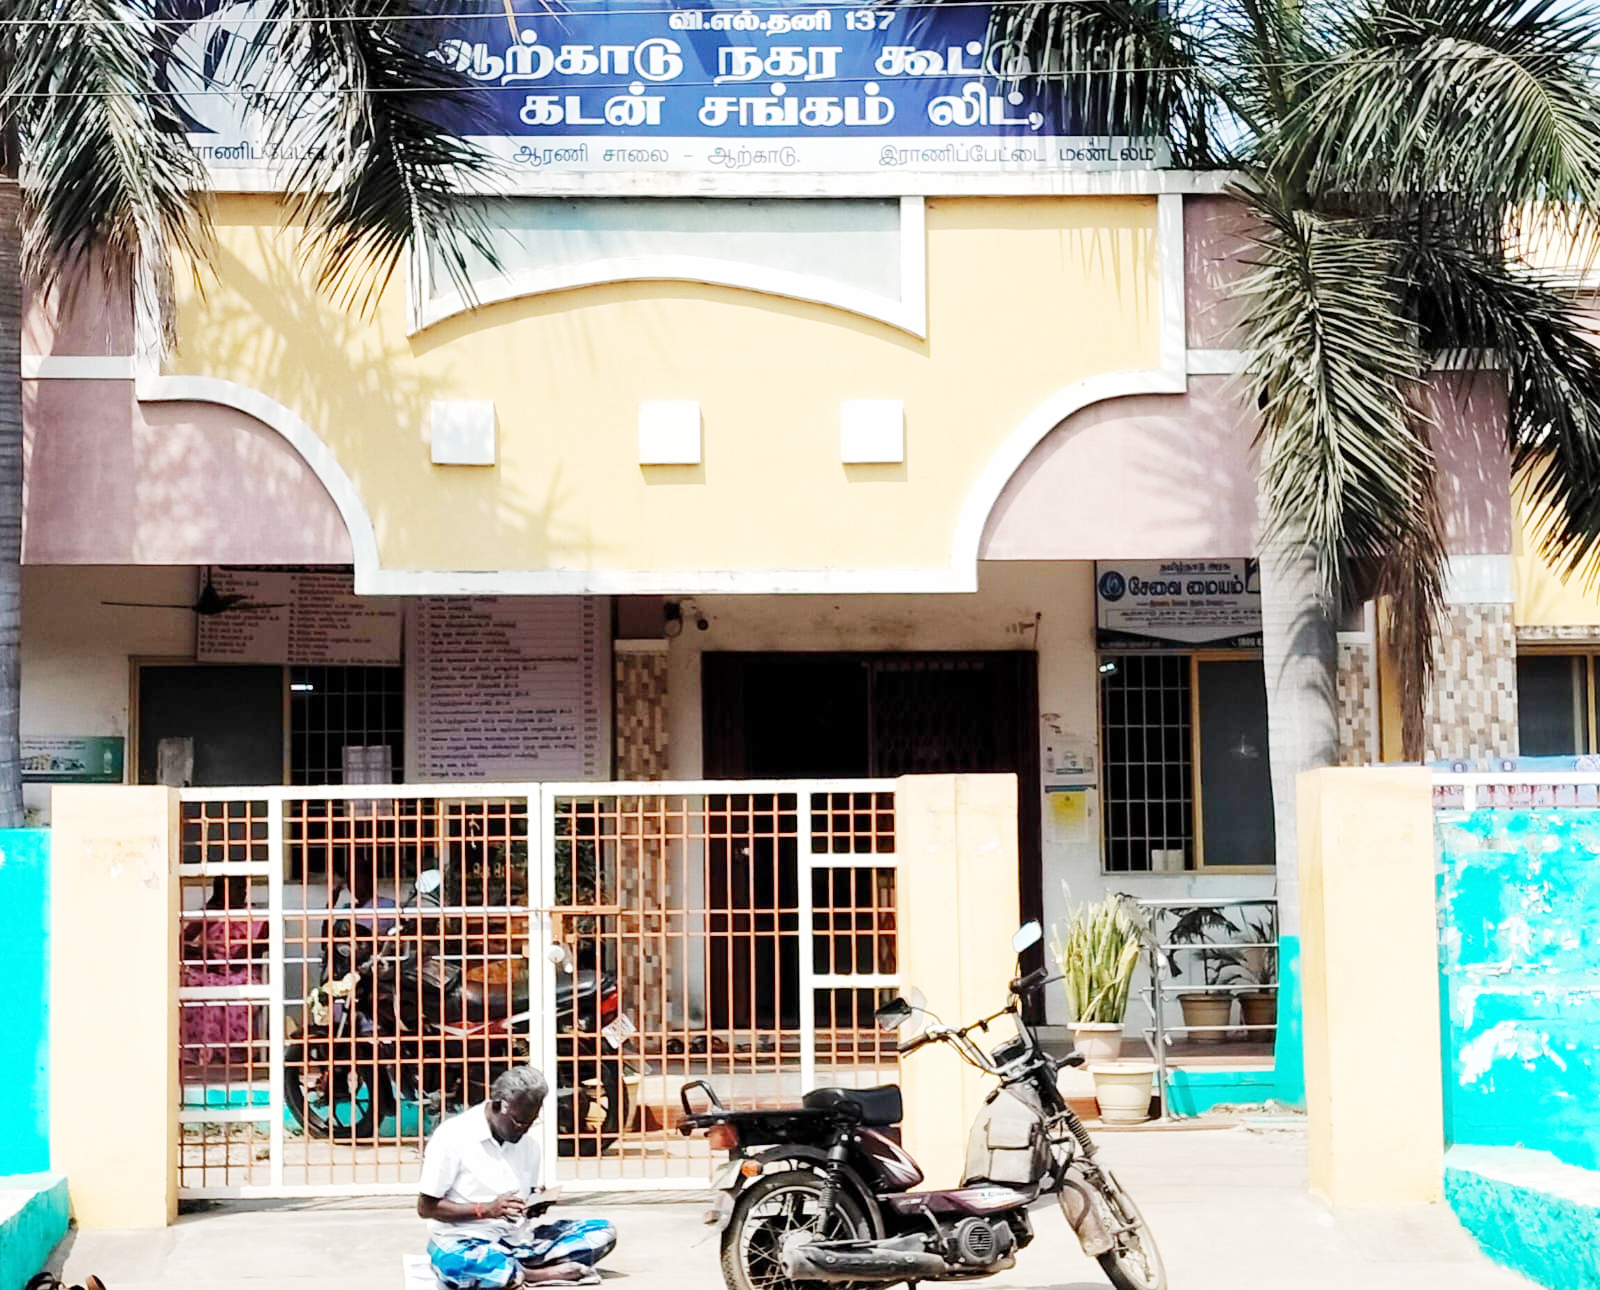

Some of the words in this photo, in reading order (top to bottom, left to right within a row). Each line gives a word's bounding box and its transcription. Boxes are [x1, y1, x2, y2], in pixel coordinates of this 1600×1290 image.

[668, 10, 832, 37] வி.எல்.தனி
[845, 10, 897, 31] 137
[426, 29, 684, 86] ஆற்காடு
[713, 46, 843, 87] நகர
[519, 81, 666, 126] கடன்
[699, 81, 896, 127] சங்கம்
[927, 81, 1044, 130] லிட்,
[512, 143, 588, 167] ஆரணி
[602, 148, 669, 163] சாலை
[878, 144, 1046, 167] இராணிப்பேட்டை
[1128, 576, 1182, 596] சேவை
[1186, 574, 1244, 596] மையம்
